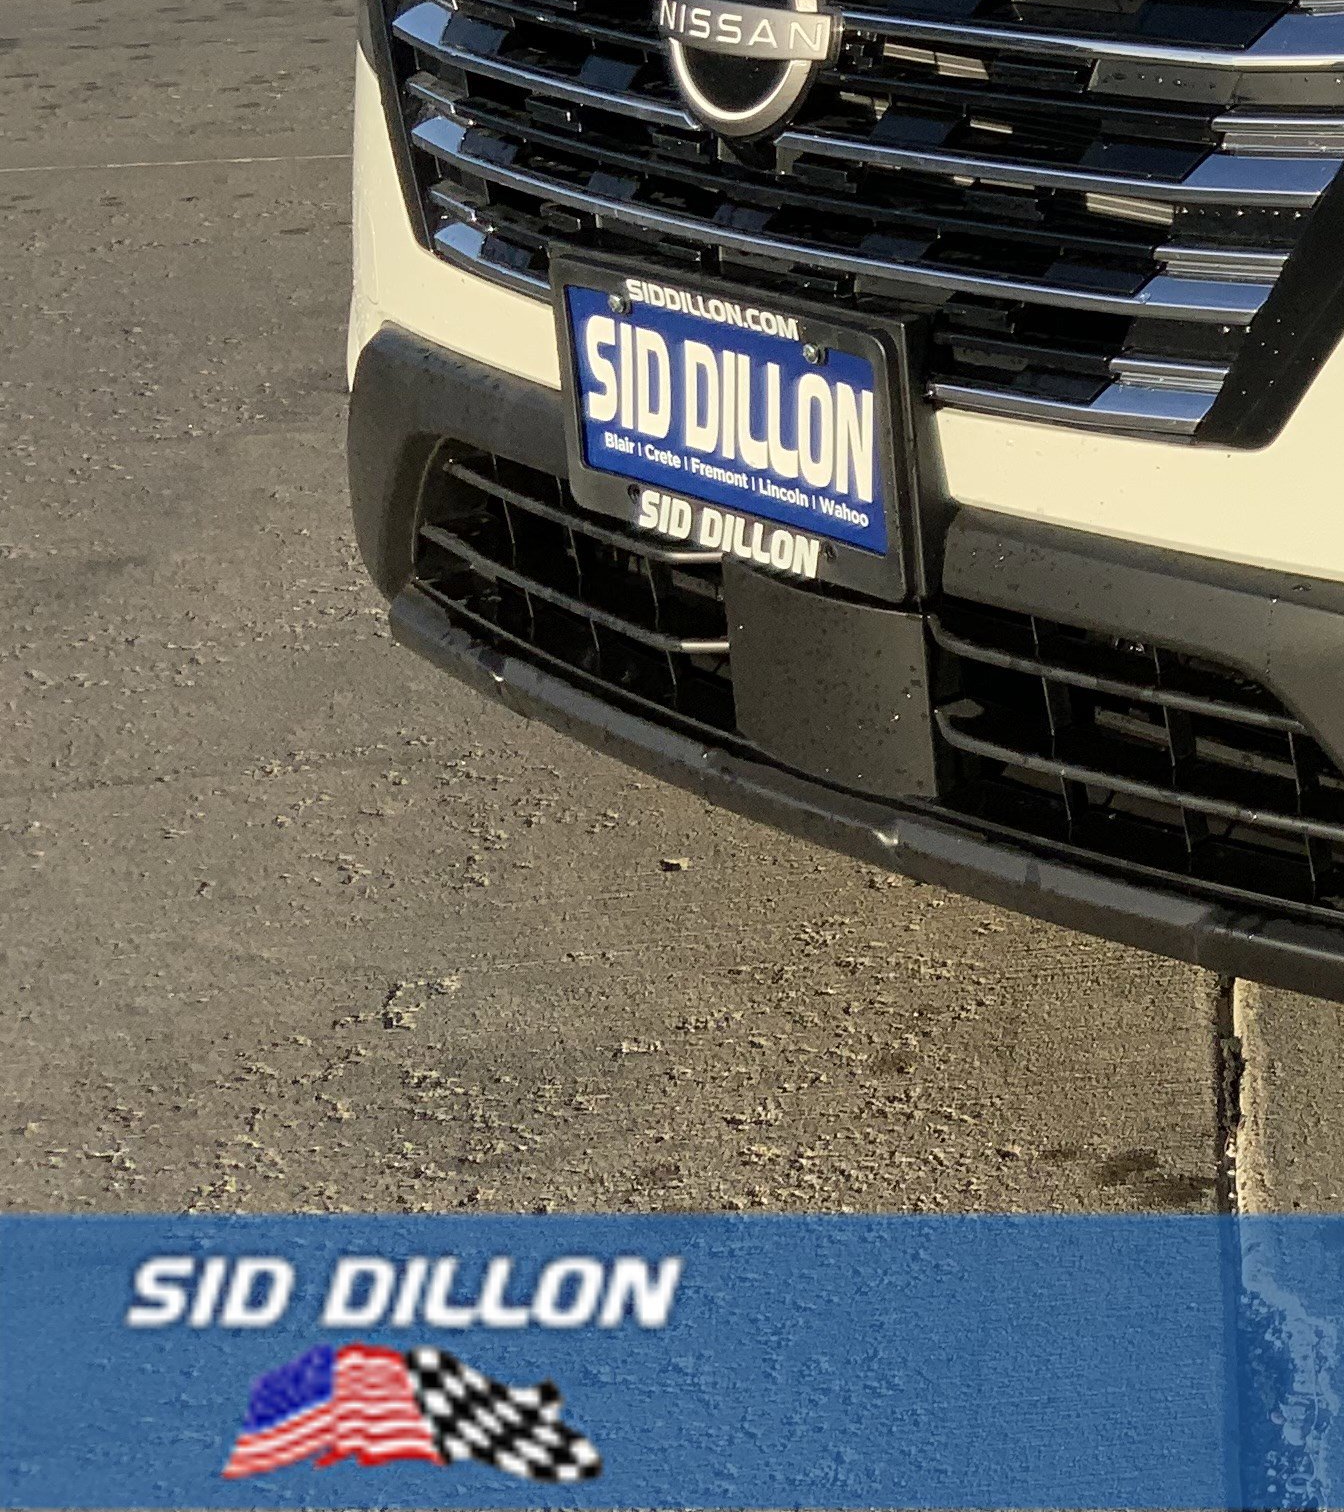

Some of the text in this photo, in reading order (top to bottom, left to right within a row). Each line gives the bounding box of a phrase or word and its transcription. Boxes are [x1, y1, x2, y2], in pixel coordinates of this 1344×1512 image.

[625, 278, 800, 342] SIDDILLON.COM
[585, 314, 874, 504] SID DILLON
[604, 431, 870, 529] Blair Crete Fremont Lincoln Wahoo
[638, 489, 820, 580] SID DILLON
